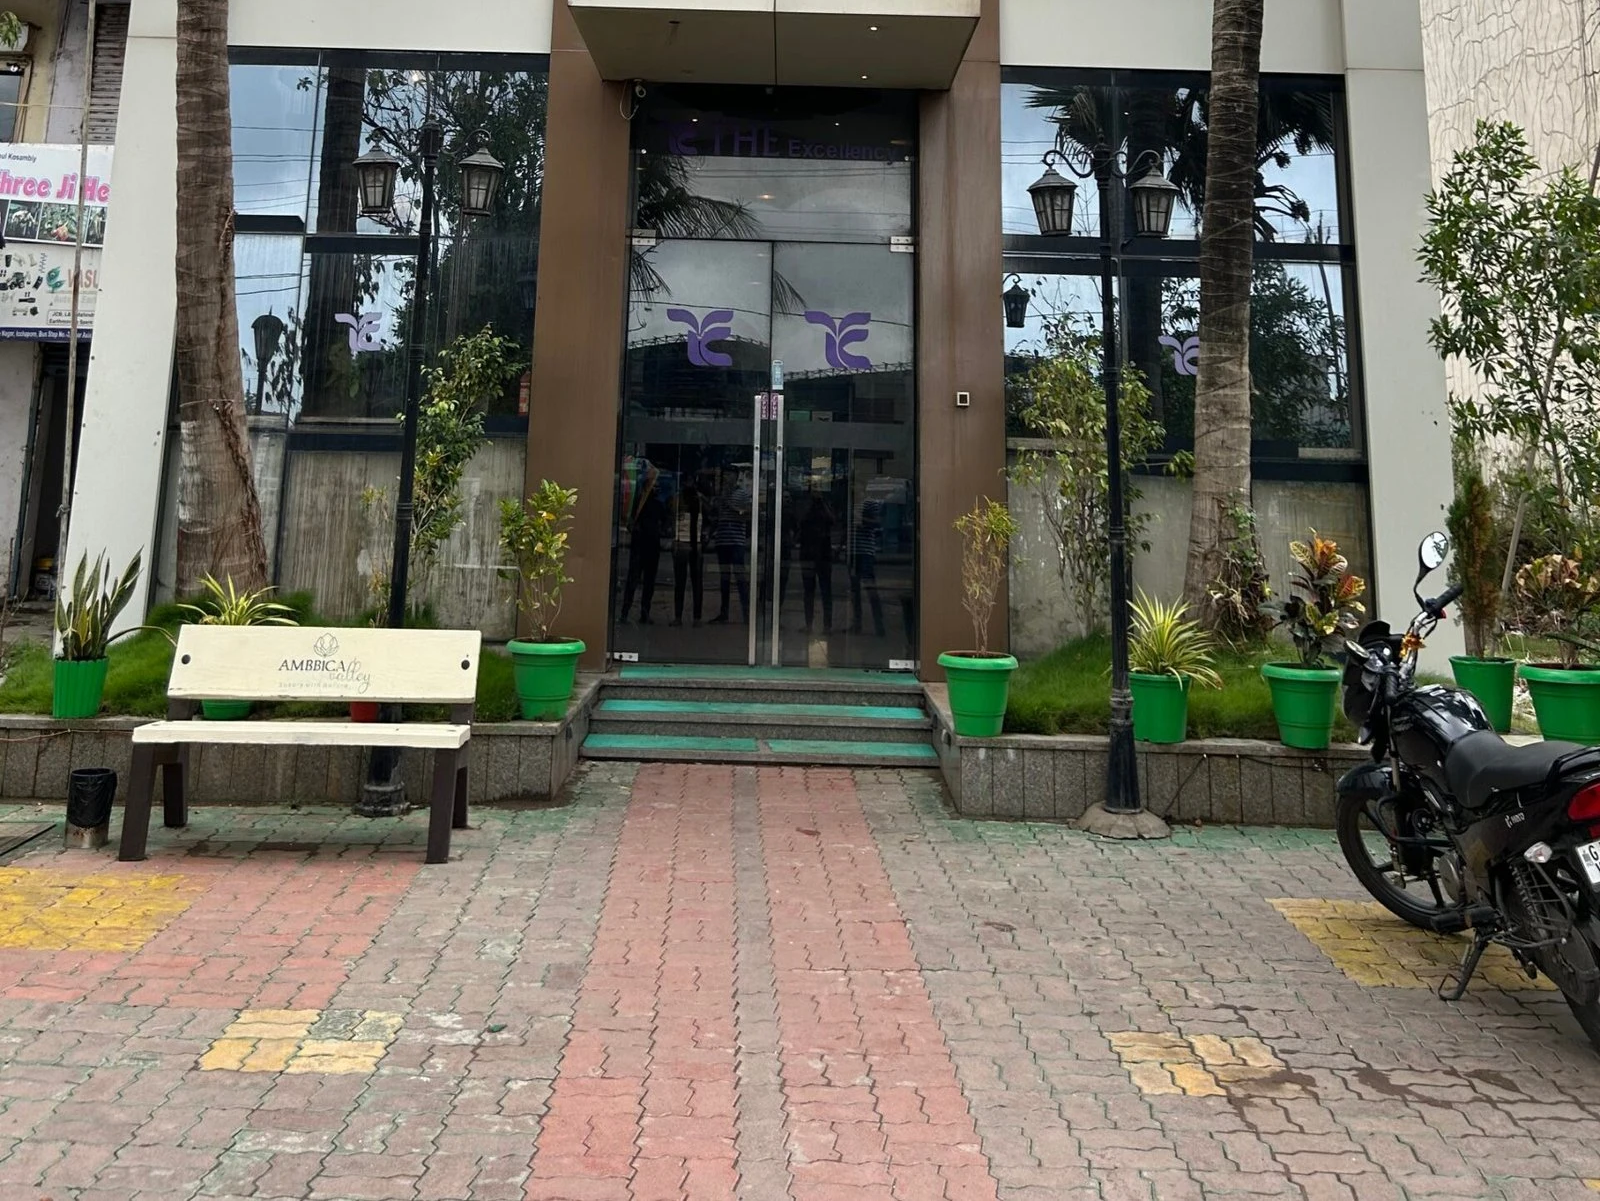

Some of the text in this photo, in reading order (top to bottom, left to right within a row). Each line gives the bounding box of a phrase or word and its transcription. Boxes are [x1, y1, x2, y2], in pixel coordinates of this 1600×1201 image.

[710, 122, 898, 166] THE Excellency
[0, 169, 52, 198] hree
[56, 172, 79, 200] Ji
[278, 659, 346, 672] AMBBICA
